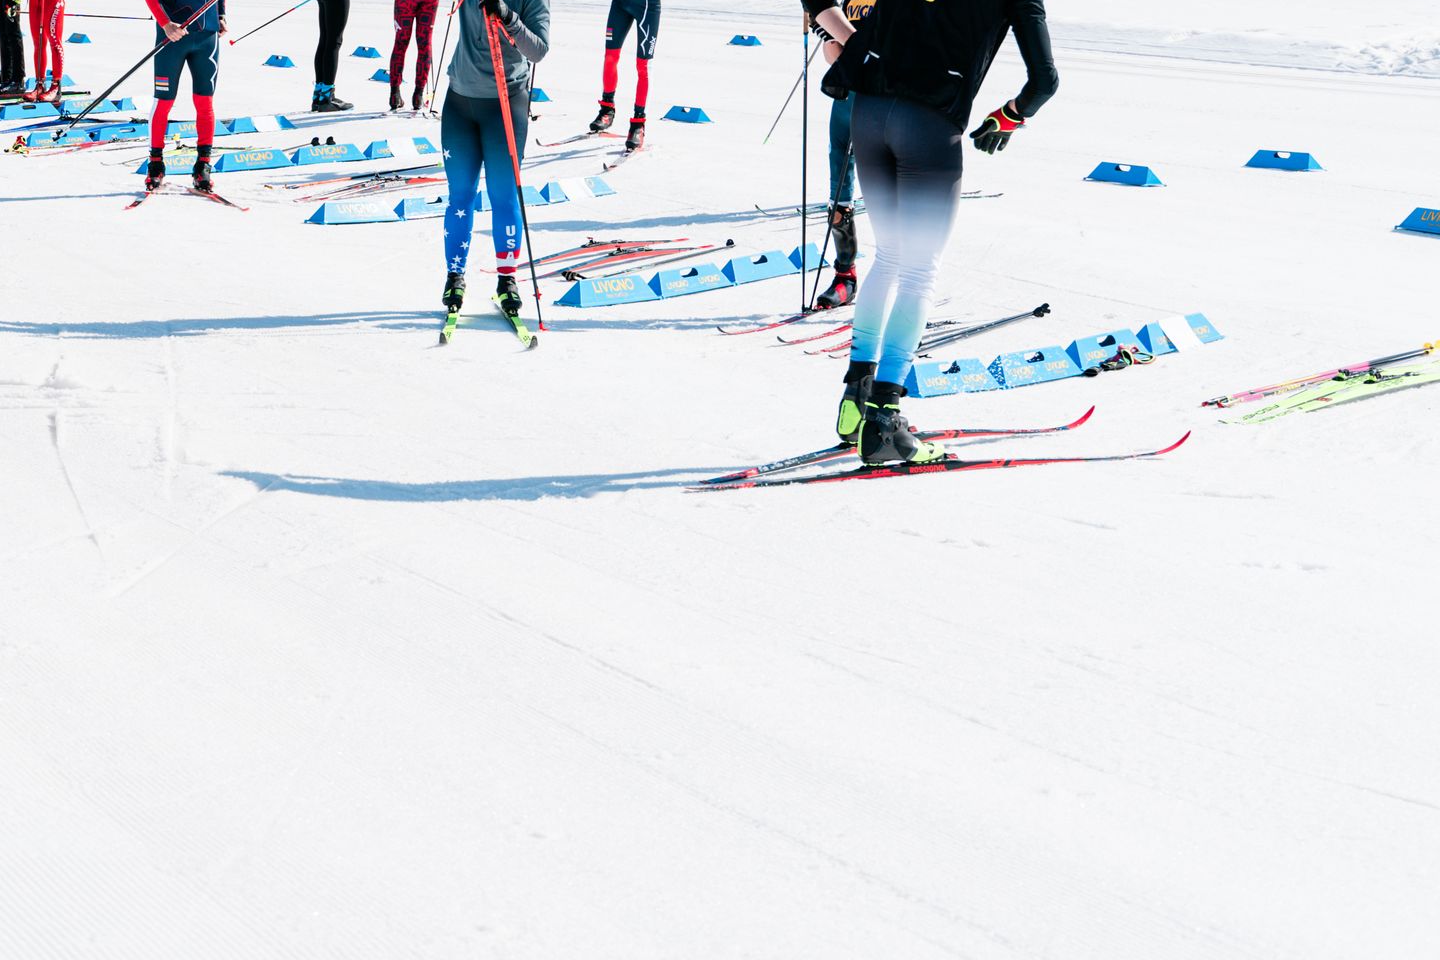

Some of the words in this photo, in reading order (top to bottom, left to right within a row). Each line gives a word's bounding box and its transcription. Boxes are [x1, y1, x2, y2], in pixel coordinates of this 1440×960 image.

[234, 151, 273, 163] LIVIGNO
[310, 144, 348, 157] LIVIGNO
[506, 224, 516, 260] USA
[591, 278, 635, 294] LIVIGNO
[909, 464, 948, 474] ROSSIGNOL
